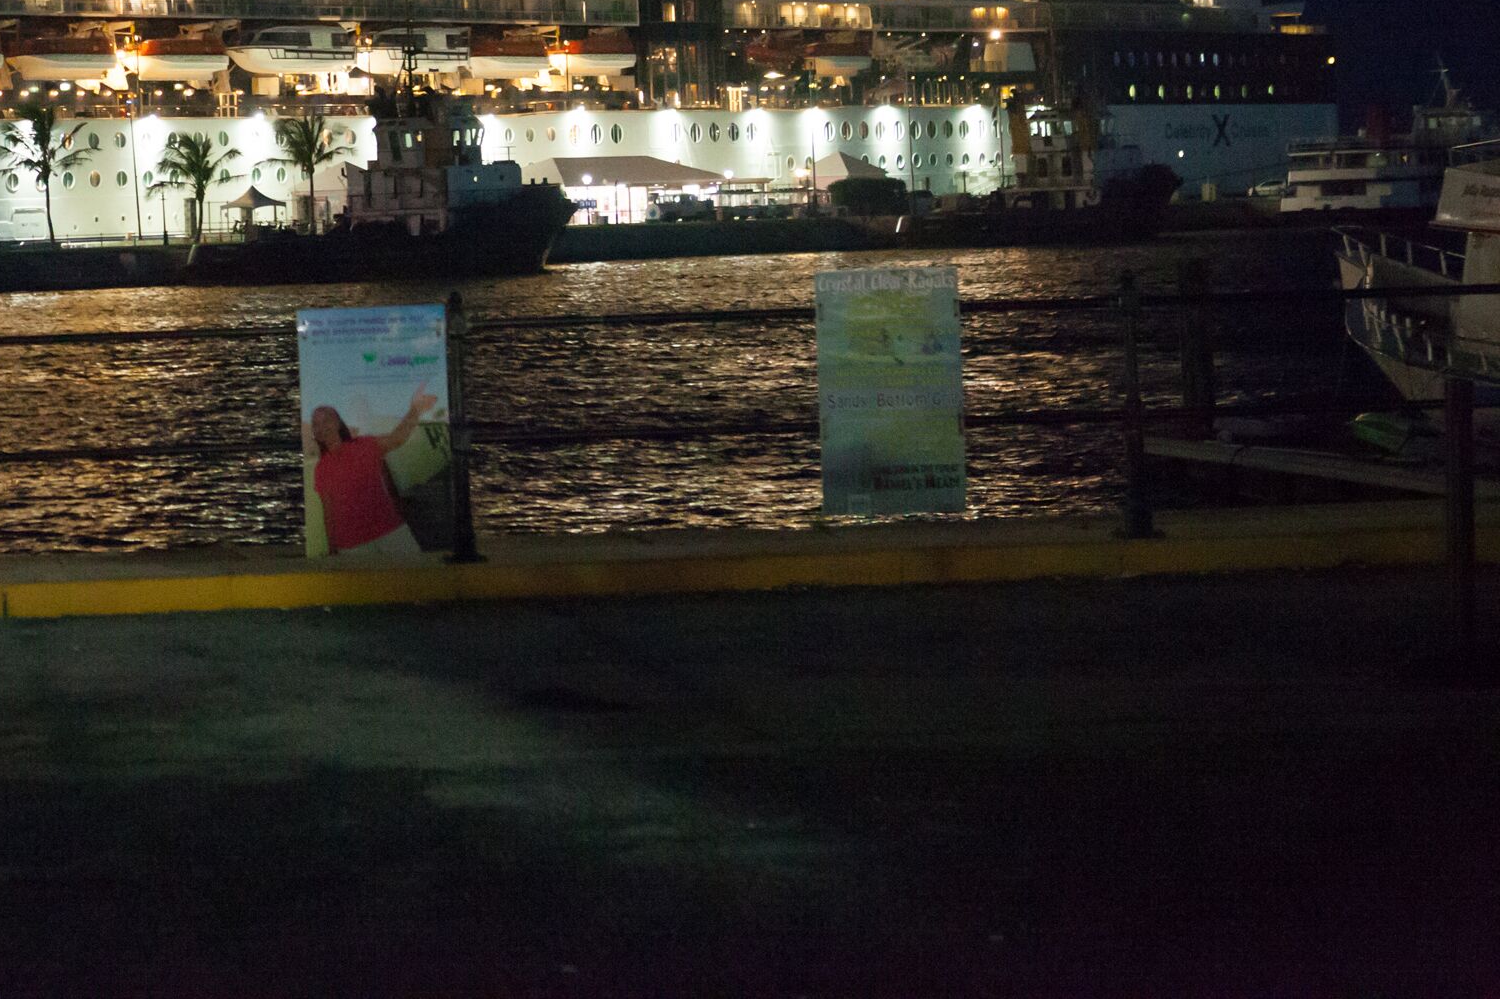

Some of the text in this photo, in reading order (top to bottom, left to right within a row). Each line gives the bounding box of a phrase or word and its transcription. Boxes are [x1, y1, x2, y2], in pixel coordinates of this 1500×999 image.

[1211, 113, 1231, 147] X
[817, 273, 866, 294] Crystal
[870, 273, 902, 290] Clear
